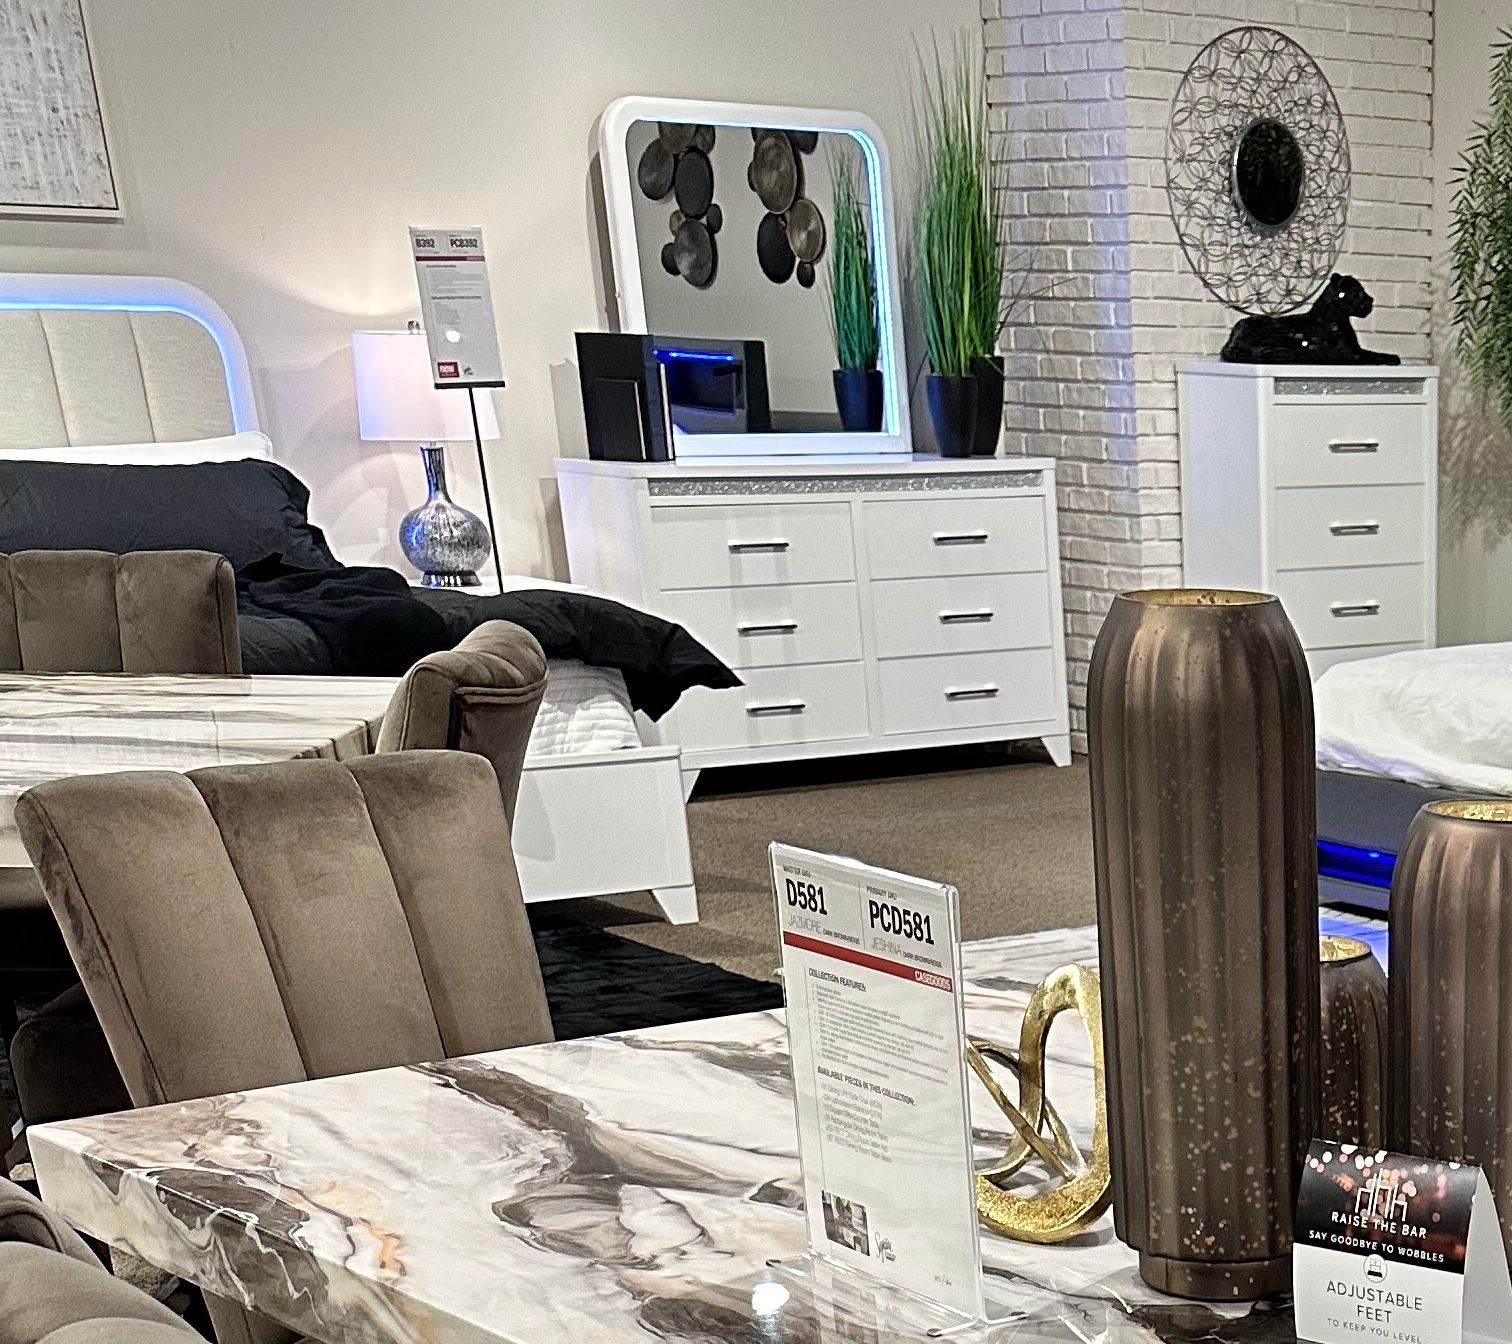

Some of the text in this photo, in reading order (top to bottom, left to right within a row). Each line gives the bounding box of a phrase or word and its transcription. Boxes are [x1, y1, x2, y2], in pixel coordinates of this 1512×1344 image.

[785, 877, 828, 916] D581
[868, 899, 935, 945] PCD581
[1331, 1211, 1427, 1240] RAISE THE BAR
[1308, 1229, 1445, 1263] SAY GOODBYE TO WOBBLES
[1326, 1280, 1423, 1311] ADJUSTABLE
[1357, 1304, 1393, 1324] FEET
[1327, 1317, 1422, 1344] TO KEEP YOU LEVEL
